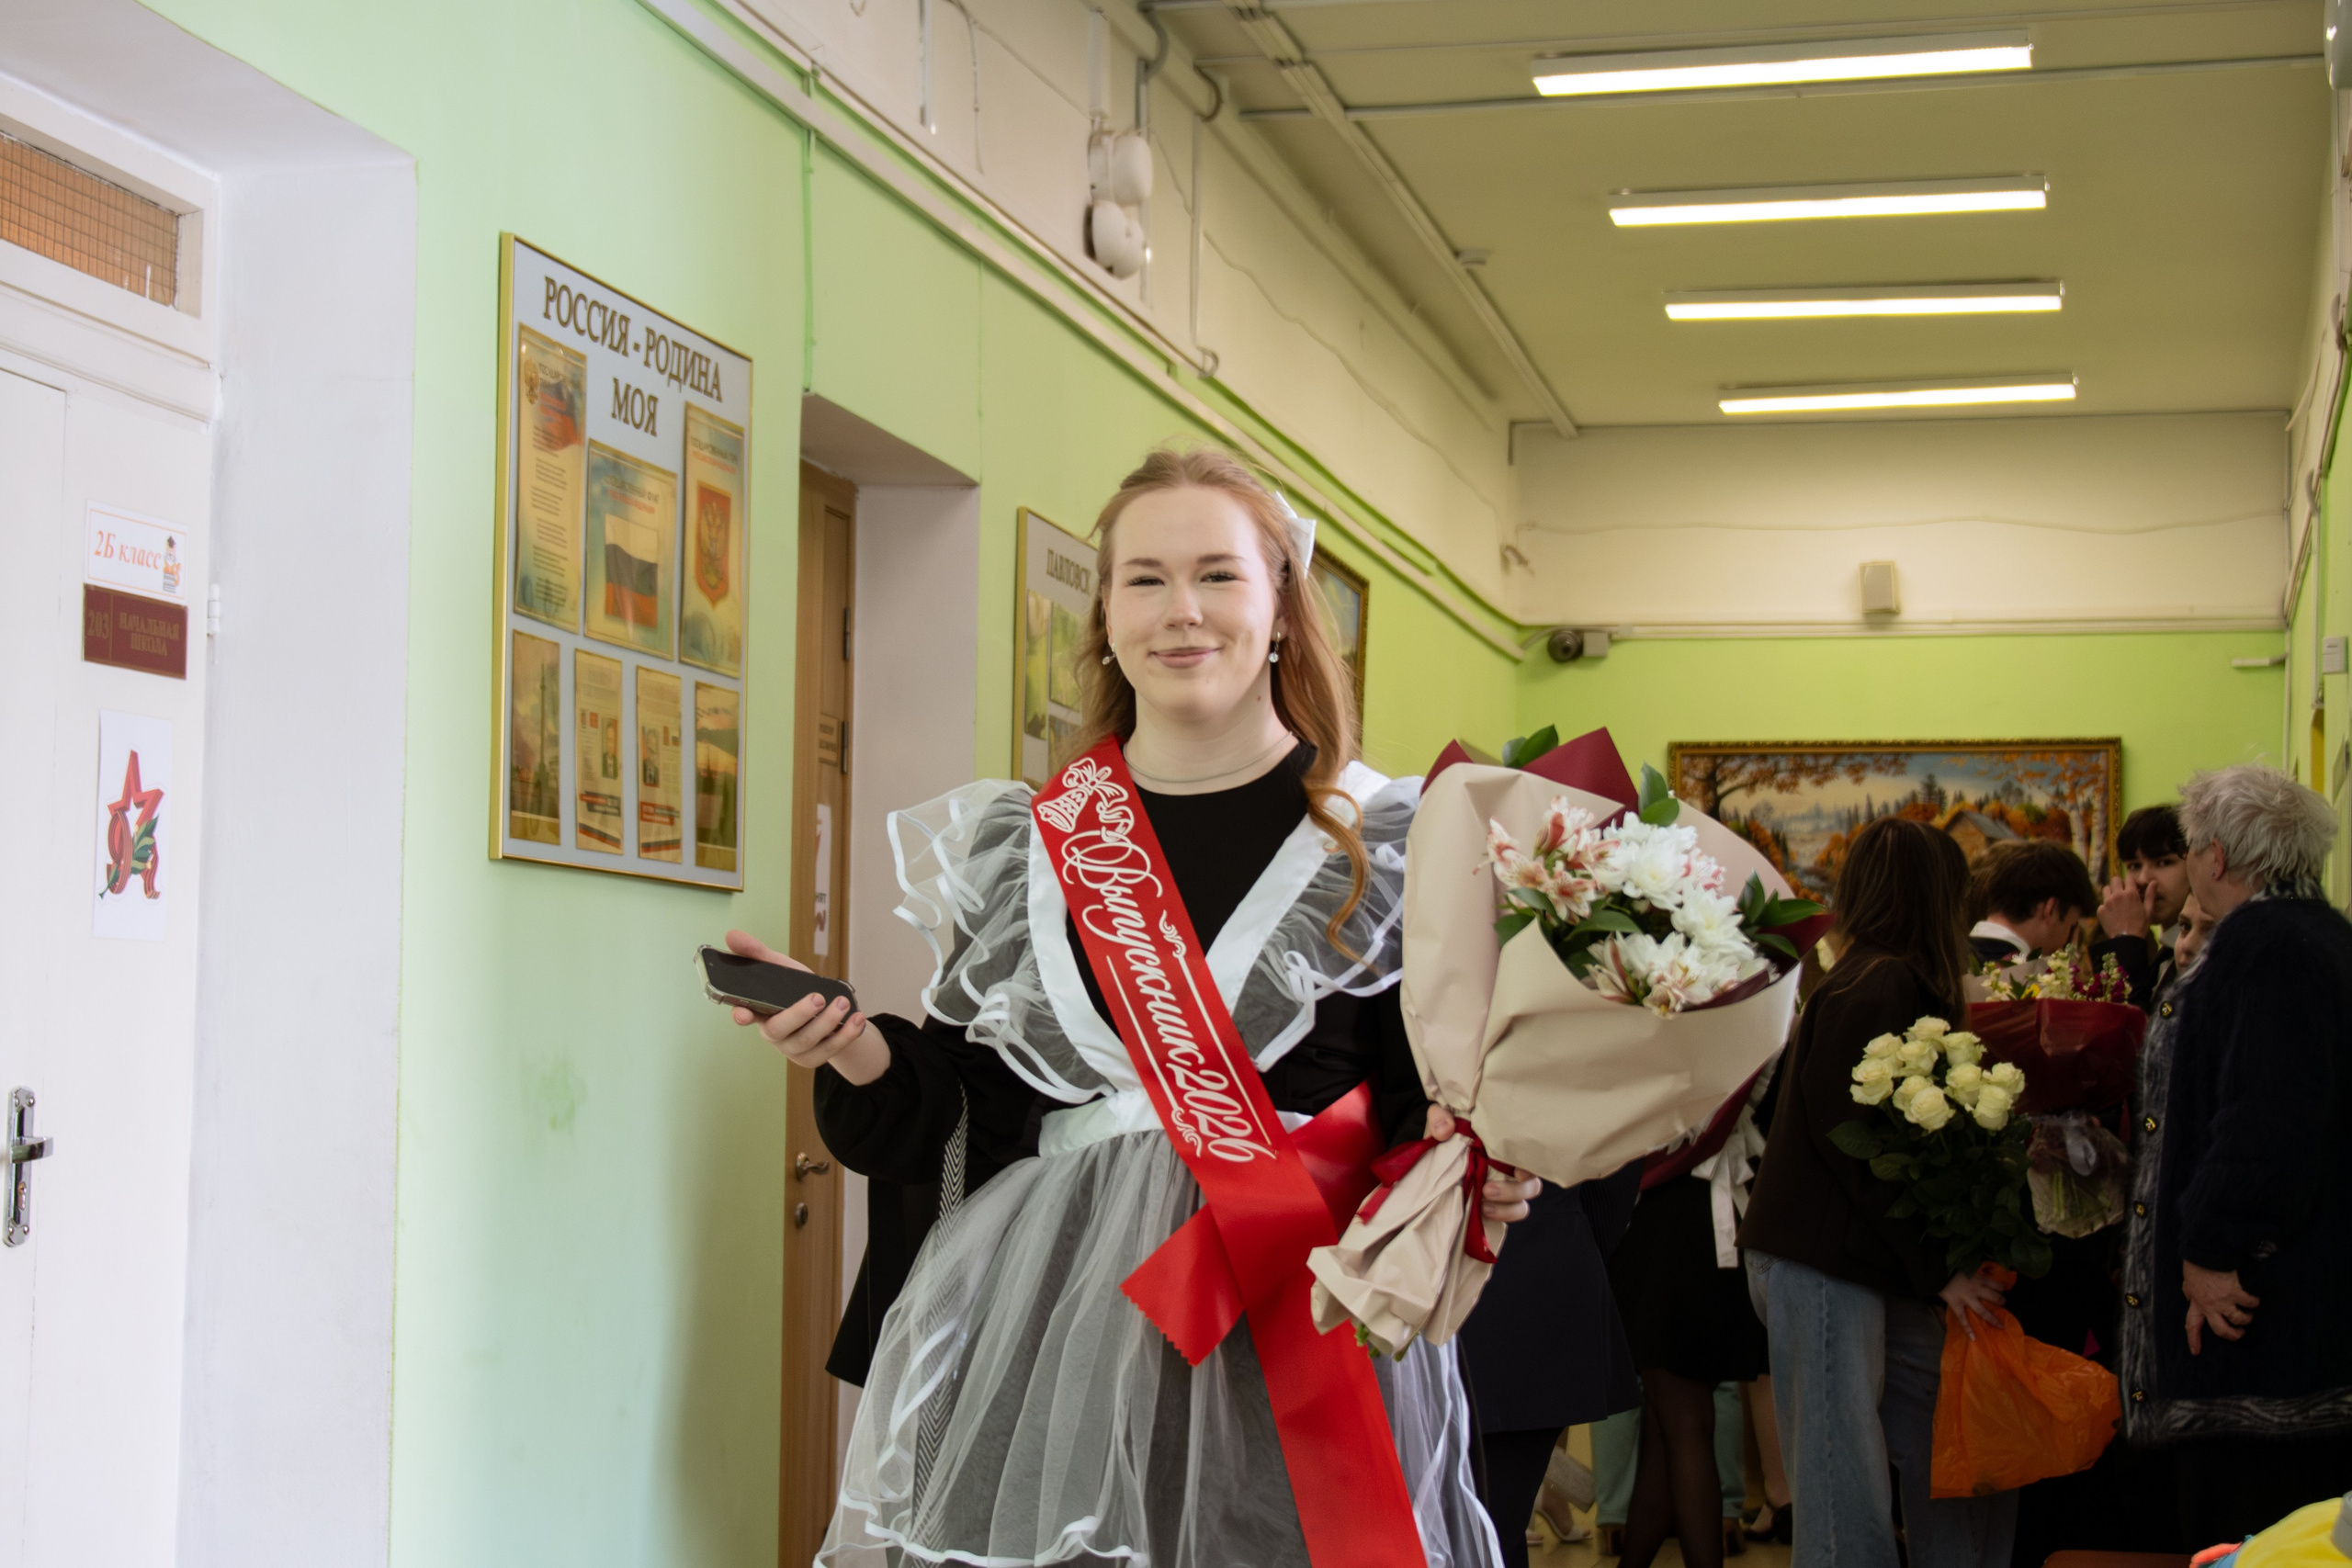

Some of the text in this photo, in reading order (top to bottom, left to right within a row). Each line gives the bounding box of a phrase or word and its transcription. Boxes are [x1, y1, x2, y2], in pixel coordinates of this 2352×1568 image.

[543, 276, 631, 358] РОССИЯ
[644, 326, 723, 402] РОДИНА
[611, 378, 659, 437] МОЯ
[94, 530, 162, 570] 2Б класс
[86, 609, 109, 639] 203
[119, 612, 179, 640] НАЧАЛЬНАЯ
[130, 633, 168, 656] ШКОЛА
[1061, 829, 1277, 1162] Выпускник 2026
